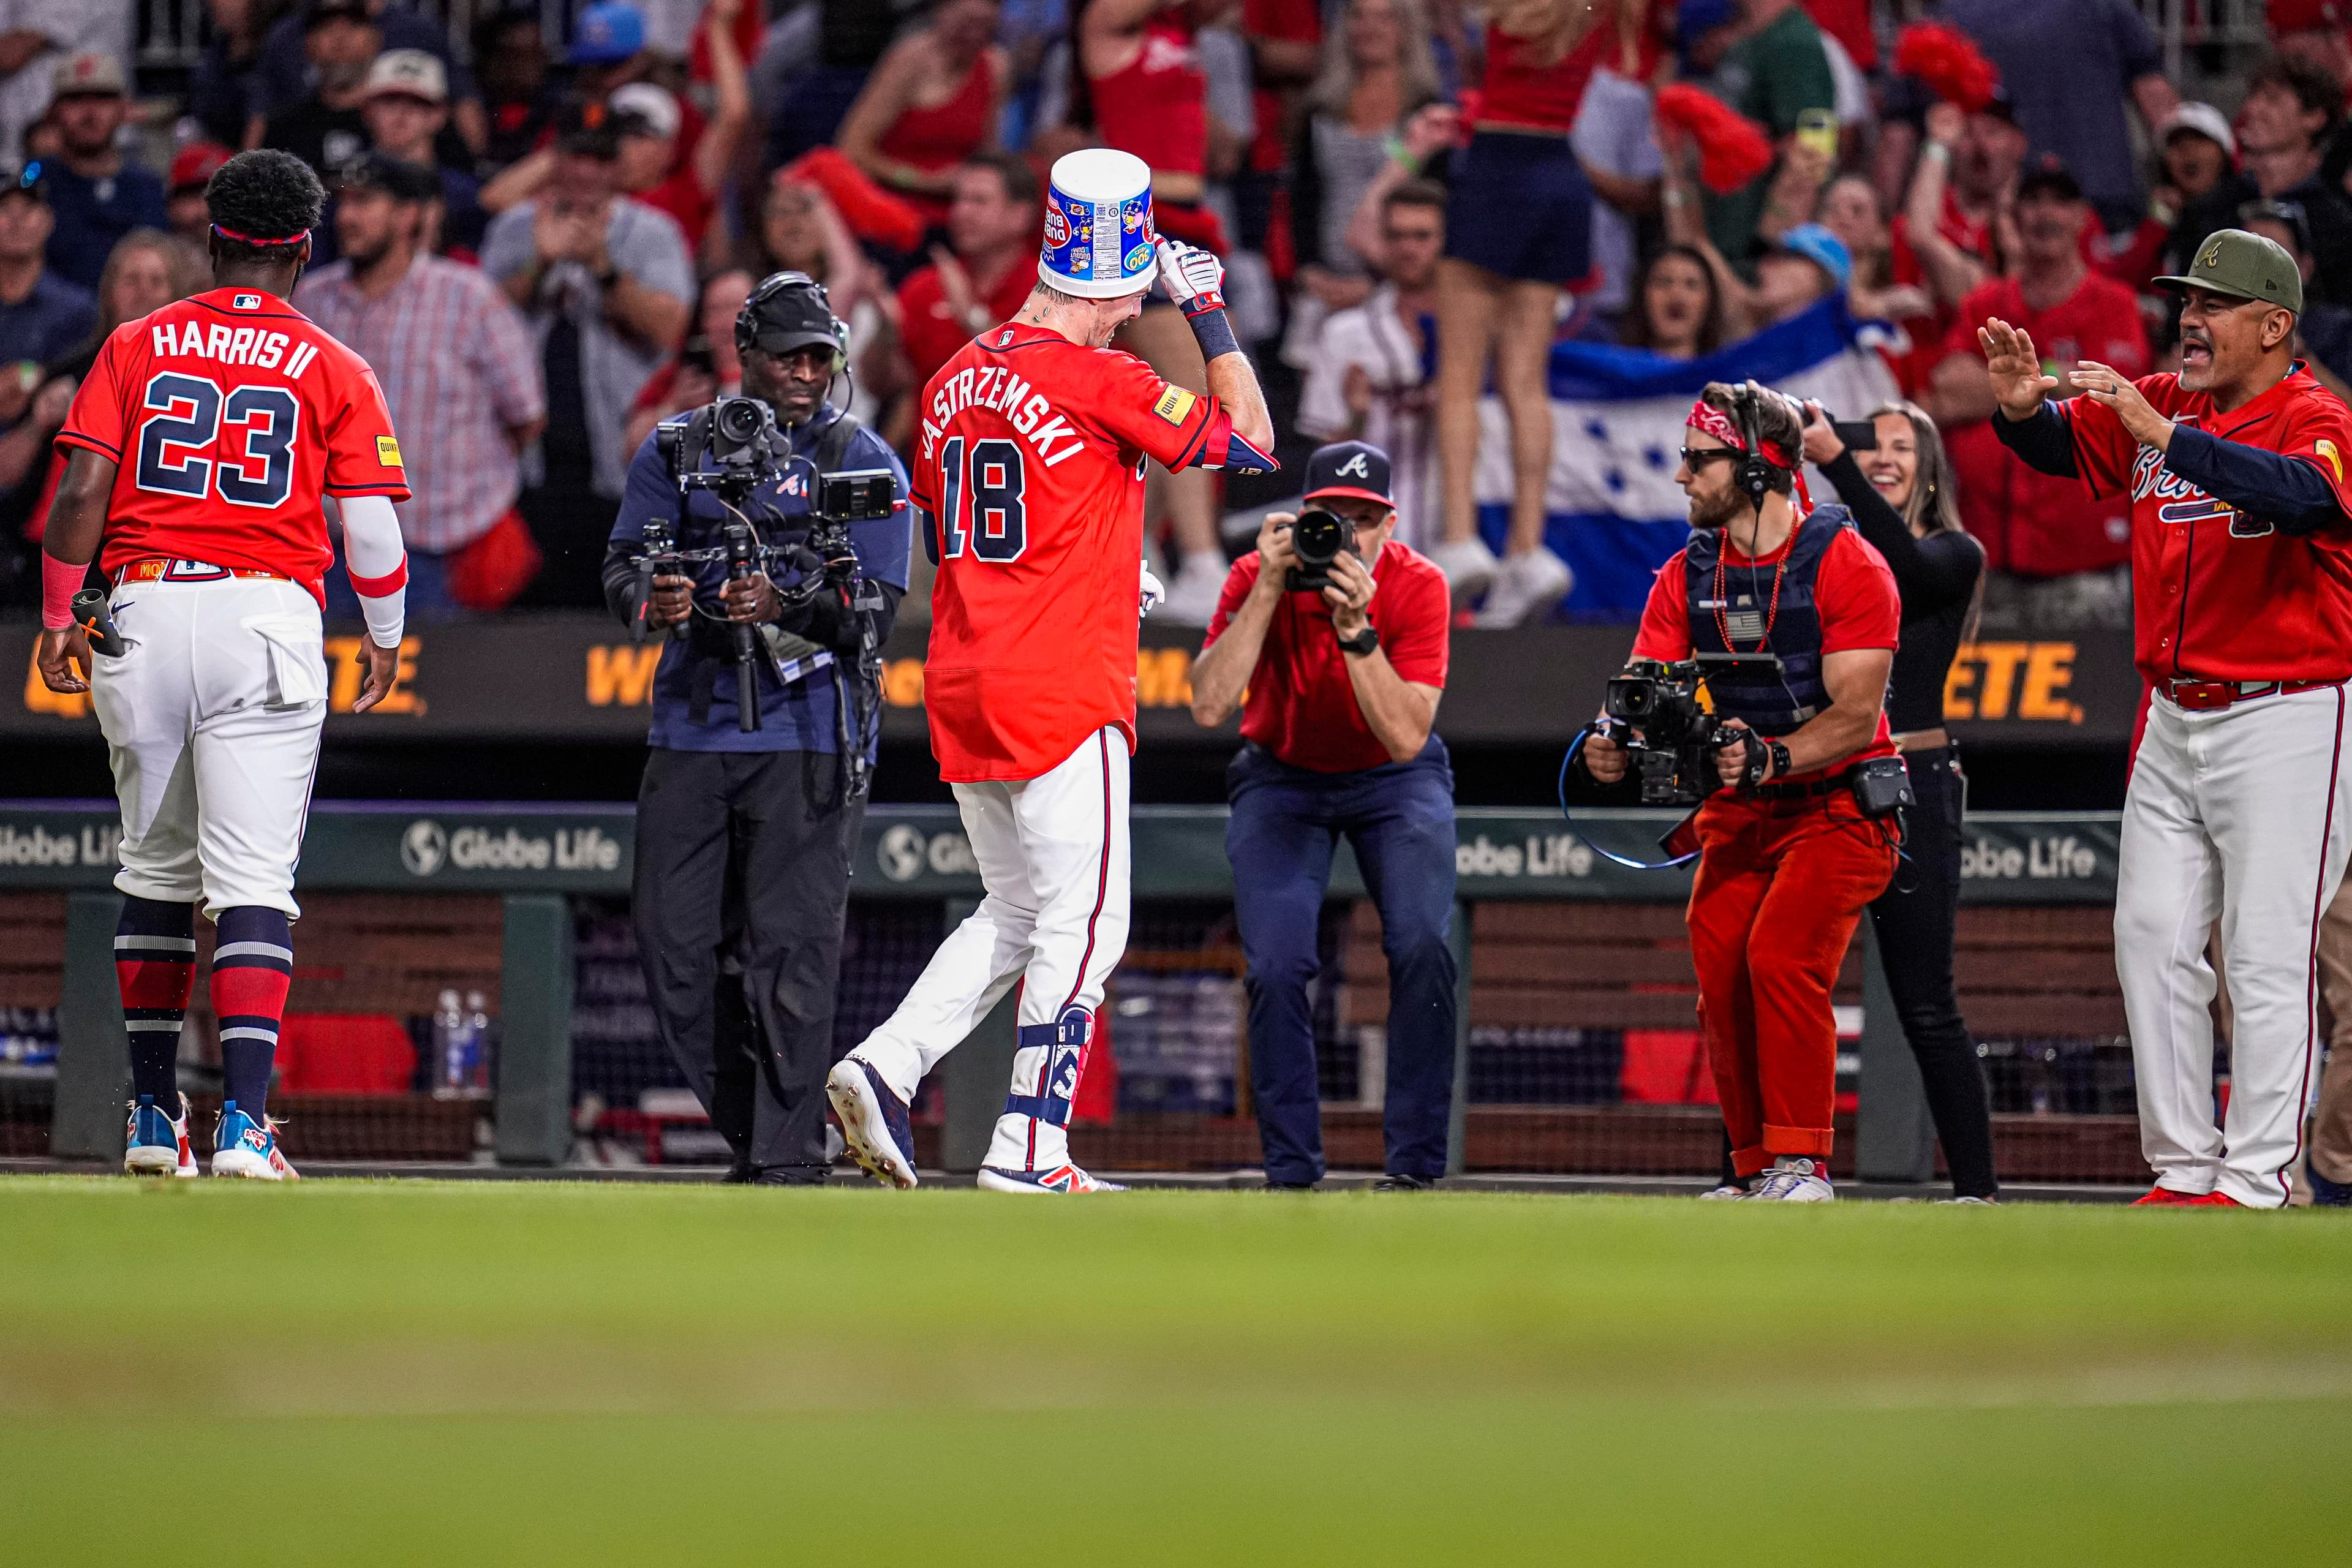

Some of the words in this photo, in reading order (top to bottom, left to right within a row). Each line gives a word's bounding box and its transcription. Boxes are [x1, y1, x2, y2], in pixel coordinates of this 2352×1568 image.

[1046, 211, 1064, 227] BUB
[1046, 228, 1066, 241] DUB
[1130, 251, 1150, 270] 300
[1181, 253, 1211, 267] Franklin
[153, 321, 290, 369] HARRIS
[136, 371, 300, 510] 23
[1335, 453, 1368, 478] A
[941, 436, 1027, 562] 18
[1943, 641, 2085, 725] ETE.
[0, 824, 76, 865] lobe
[451, 827, 551, 869] Globe
[556, 827, 620, 870] Life
[1456, 834, 1522, 876] obe
[1528, 834, 1593, 876] Life
[1961, 837, 2023, 878] obe
[2029, 836, 2095, 878] Life
